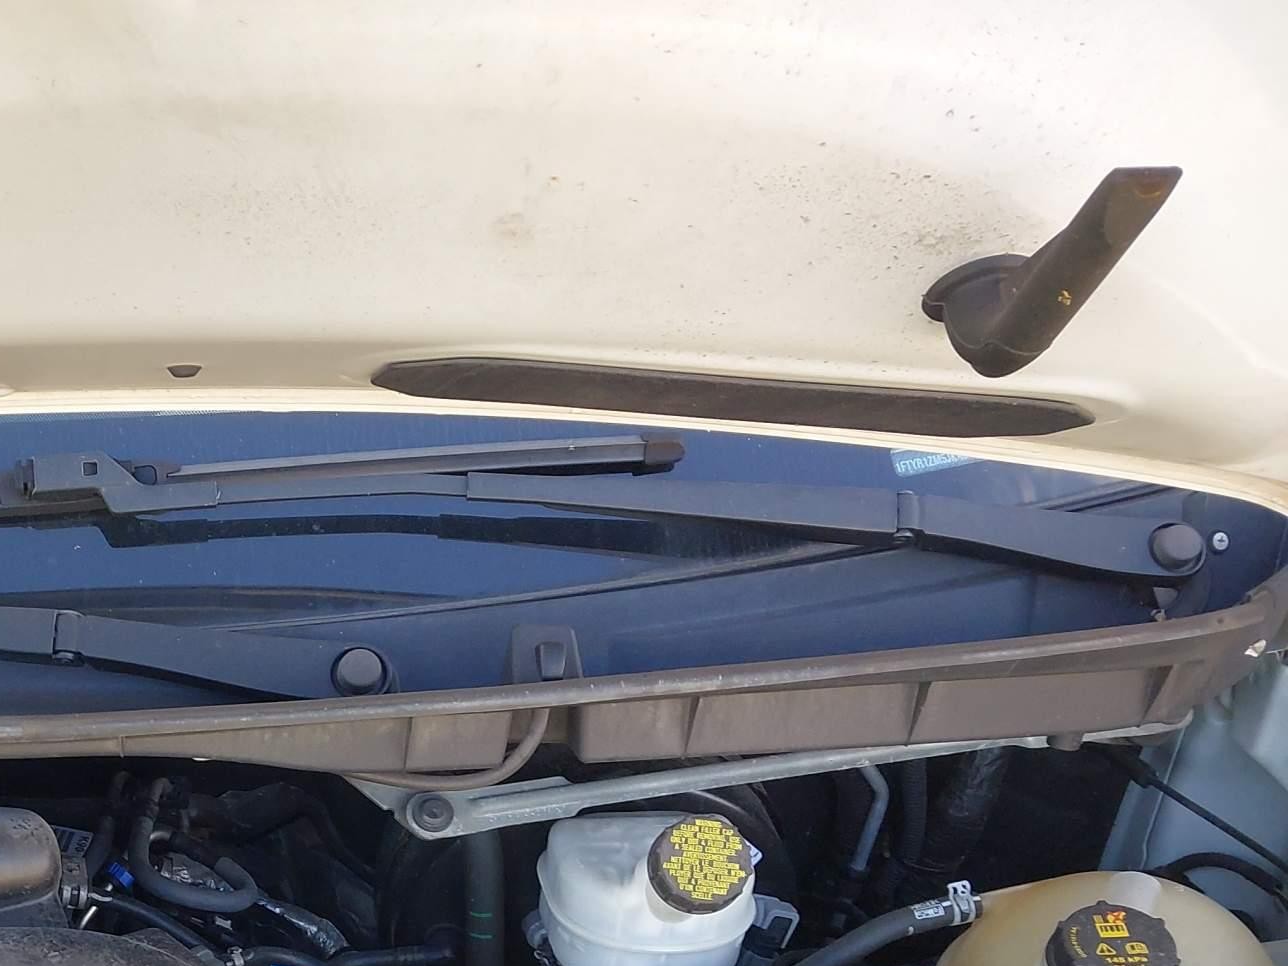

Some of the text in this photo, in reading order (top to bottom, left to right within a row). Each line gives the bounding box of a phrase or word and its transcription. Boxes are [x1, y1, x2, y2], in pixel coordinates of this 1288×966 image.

[701, 826, 720, 834] FILLER
[708, 840, 724, 848] FLUID
[726, 842, 742, 850] FROM
